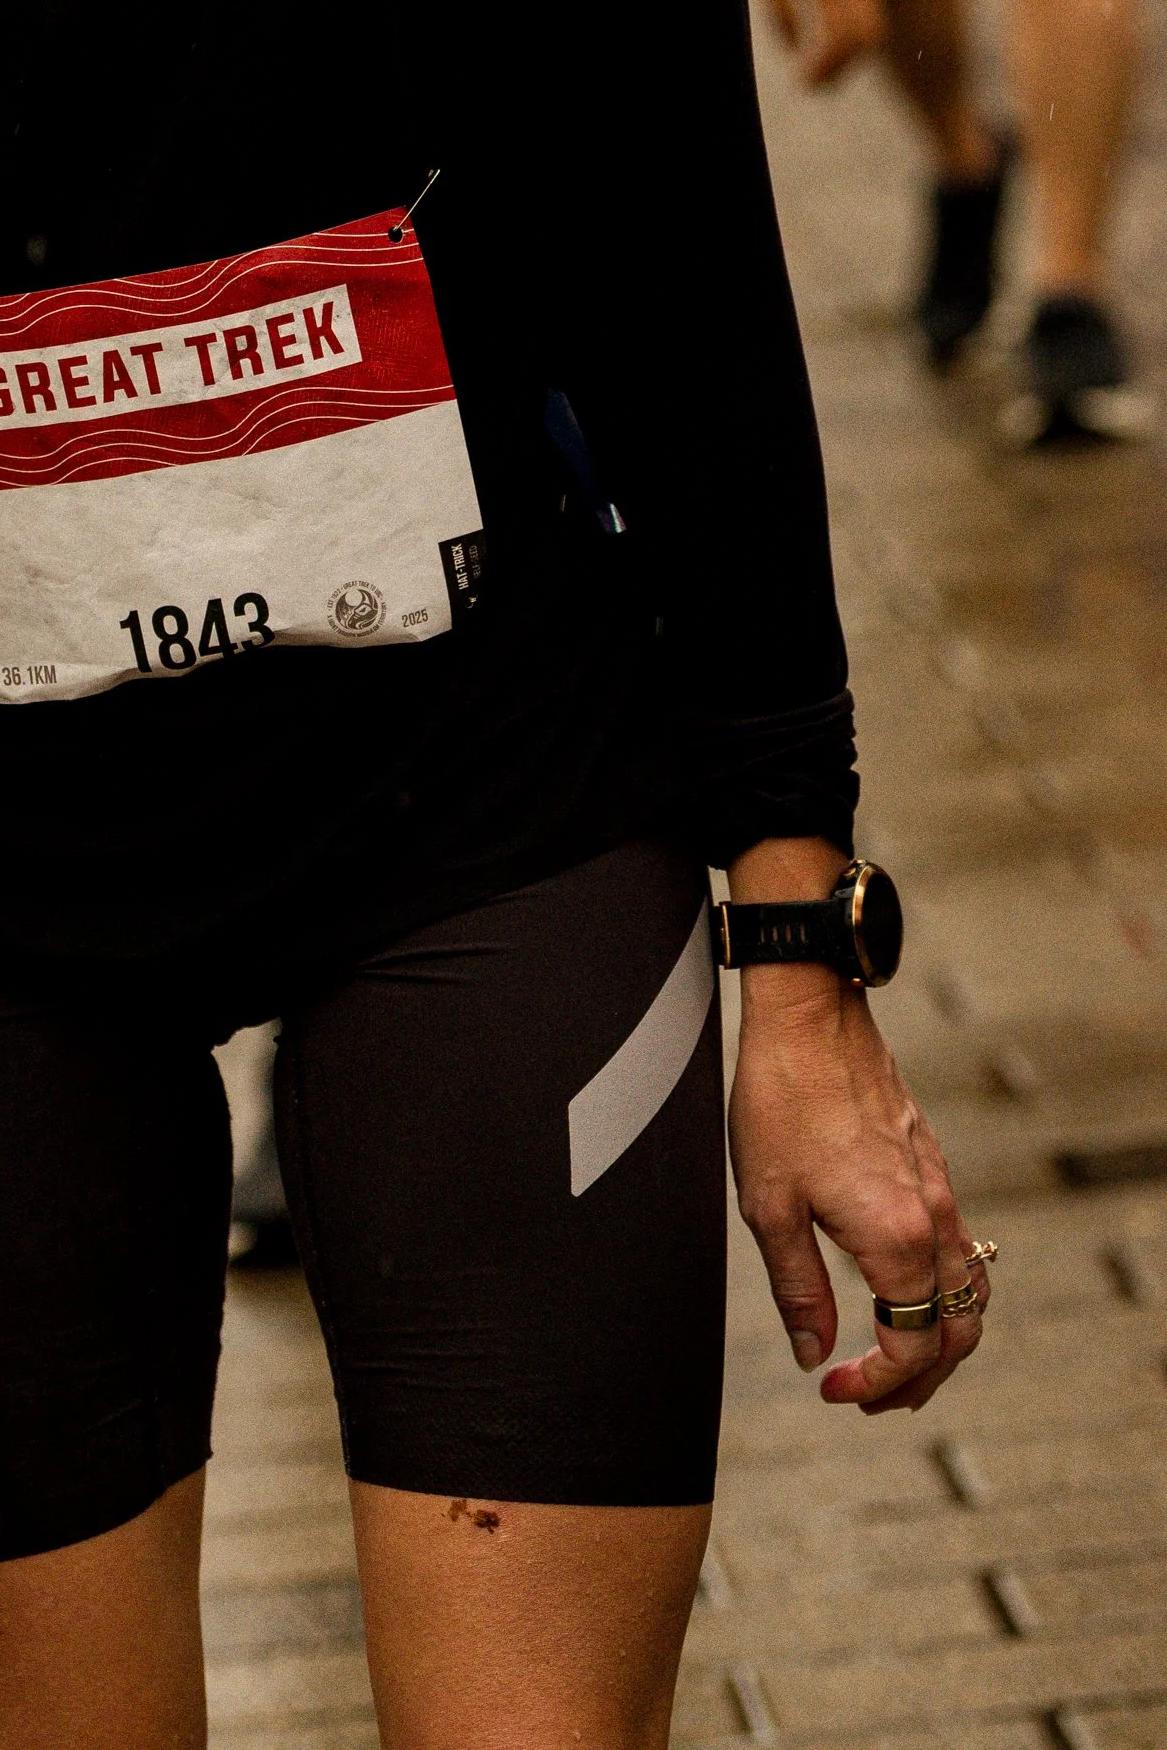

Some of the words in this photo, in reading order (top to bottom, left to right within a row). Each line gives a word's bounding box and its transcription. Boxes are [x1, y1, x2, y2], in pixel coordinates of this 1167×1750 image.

[184, 300, 346, 387] TREK
[451, 543, 469, 590] HAT-TRICK
[119, 592, 276, 674] 1843
[401, 608, 429, 628] 2025
[1, 665, 57, 686] 36.1KM
